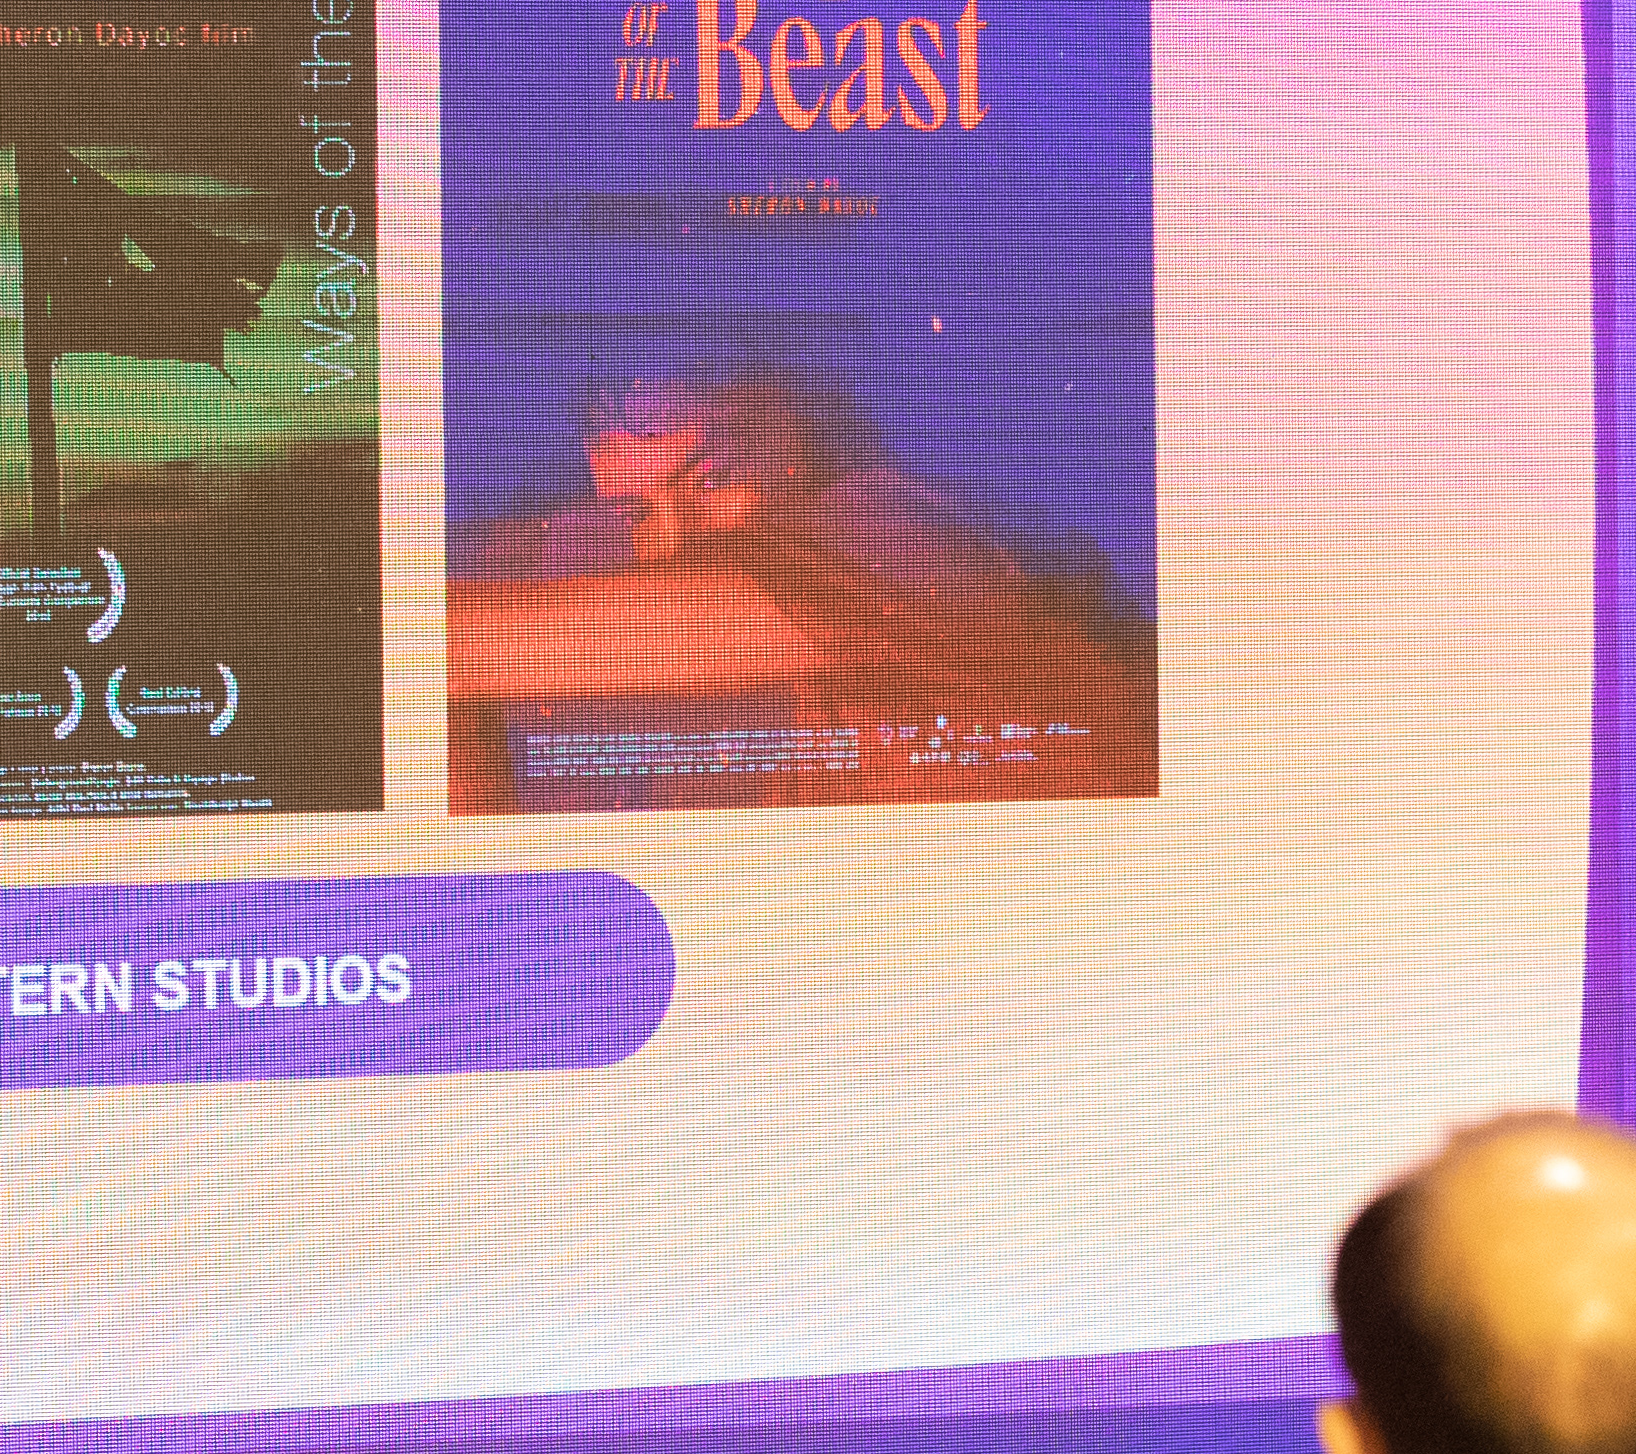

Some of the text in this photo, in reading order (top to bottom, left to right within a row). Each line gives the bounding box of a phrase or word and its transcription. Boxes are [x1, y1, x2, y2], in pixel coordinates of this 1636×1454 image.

[300, 114, 355, 179] of
[303, 204, 369, 394] Ways
[151, 954, 412, 1012] STUDIOS
